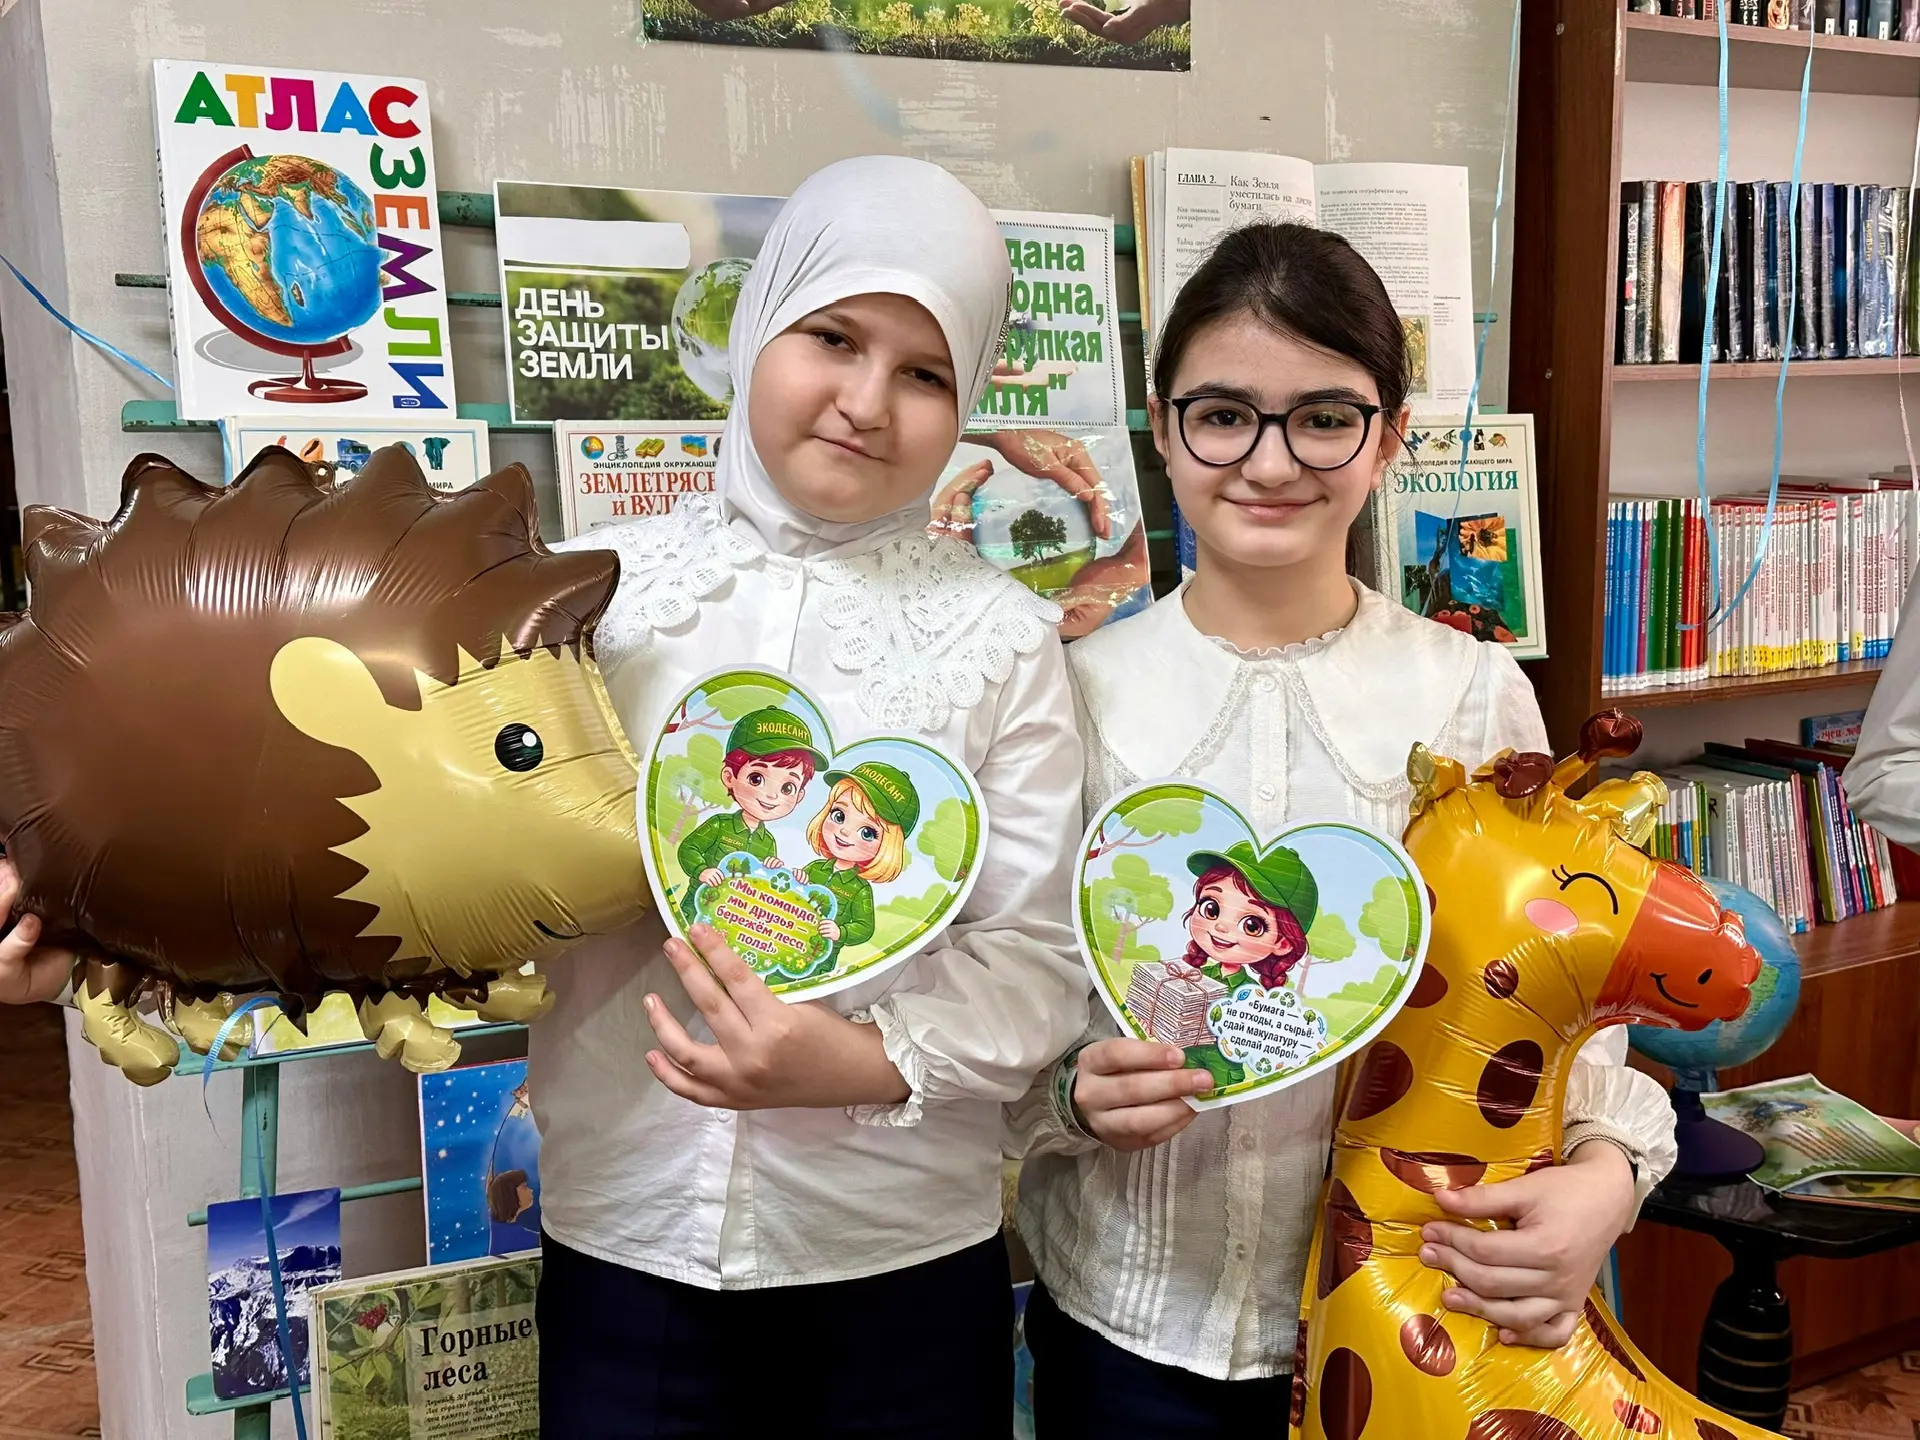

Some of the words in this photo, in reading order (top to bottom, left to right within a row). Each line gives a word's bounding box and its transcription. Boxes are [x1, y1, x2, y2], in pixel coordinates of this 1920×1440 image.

[174, 71, 421, 139] АТЛАС
[1230, 175, 1249, 188] Как
[1252, 176, 1280, 190] Земля
[369, 142, 449, 410] ЗЕМЛИ
[515, 287, 605, 321] ДЕНЬ
[516, 320, 669, 353] ЗАЩИТЫ
[1001, 328, 1103, 372] рупкая
[519, 350, 633, 380] ЗЕМЛИ
[593, 461, 661, 470] ЭНЦИКЛОПЕДИЯ
[1394, 471, 1519, 493] ЭКОЛОГИЯ
[756, 722, 809, 741] ЭКОДЕСАНТ
[858, 766, 906, 803] ЭКОДЕСАНТ
[727, 895, 749, 910] мы
[748, 905, 795, 930] друзья
[729, 879, 758, 898] «Мы
[759, 892, 818, 925] команда,
[716, 905, 773, 937] бережём
[774, 932, 807, 953] леса,
[737, 932, 778, 954] поля!»
[1226, 1008, 1237, 1017] не
[1239, 1010, 1274, 1029] отходы,
[1276, 1021, 1282, 1029] а
[1284, 1023, 1315, 1039] сырьё:
[1248, 999, 1285, 1017] «Бумага
[1223, 1019, 1245, 1032] сдай
[1246, 1026, 1299, 1049] макулатуру
[1230, 1035, 1263, 1050] сделай
[1263, 1043, 1299, 1060] добро!»
[420, 1317, 532, 1357] Горные
[424, 1360, 488, 1392] леса
